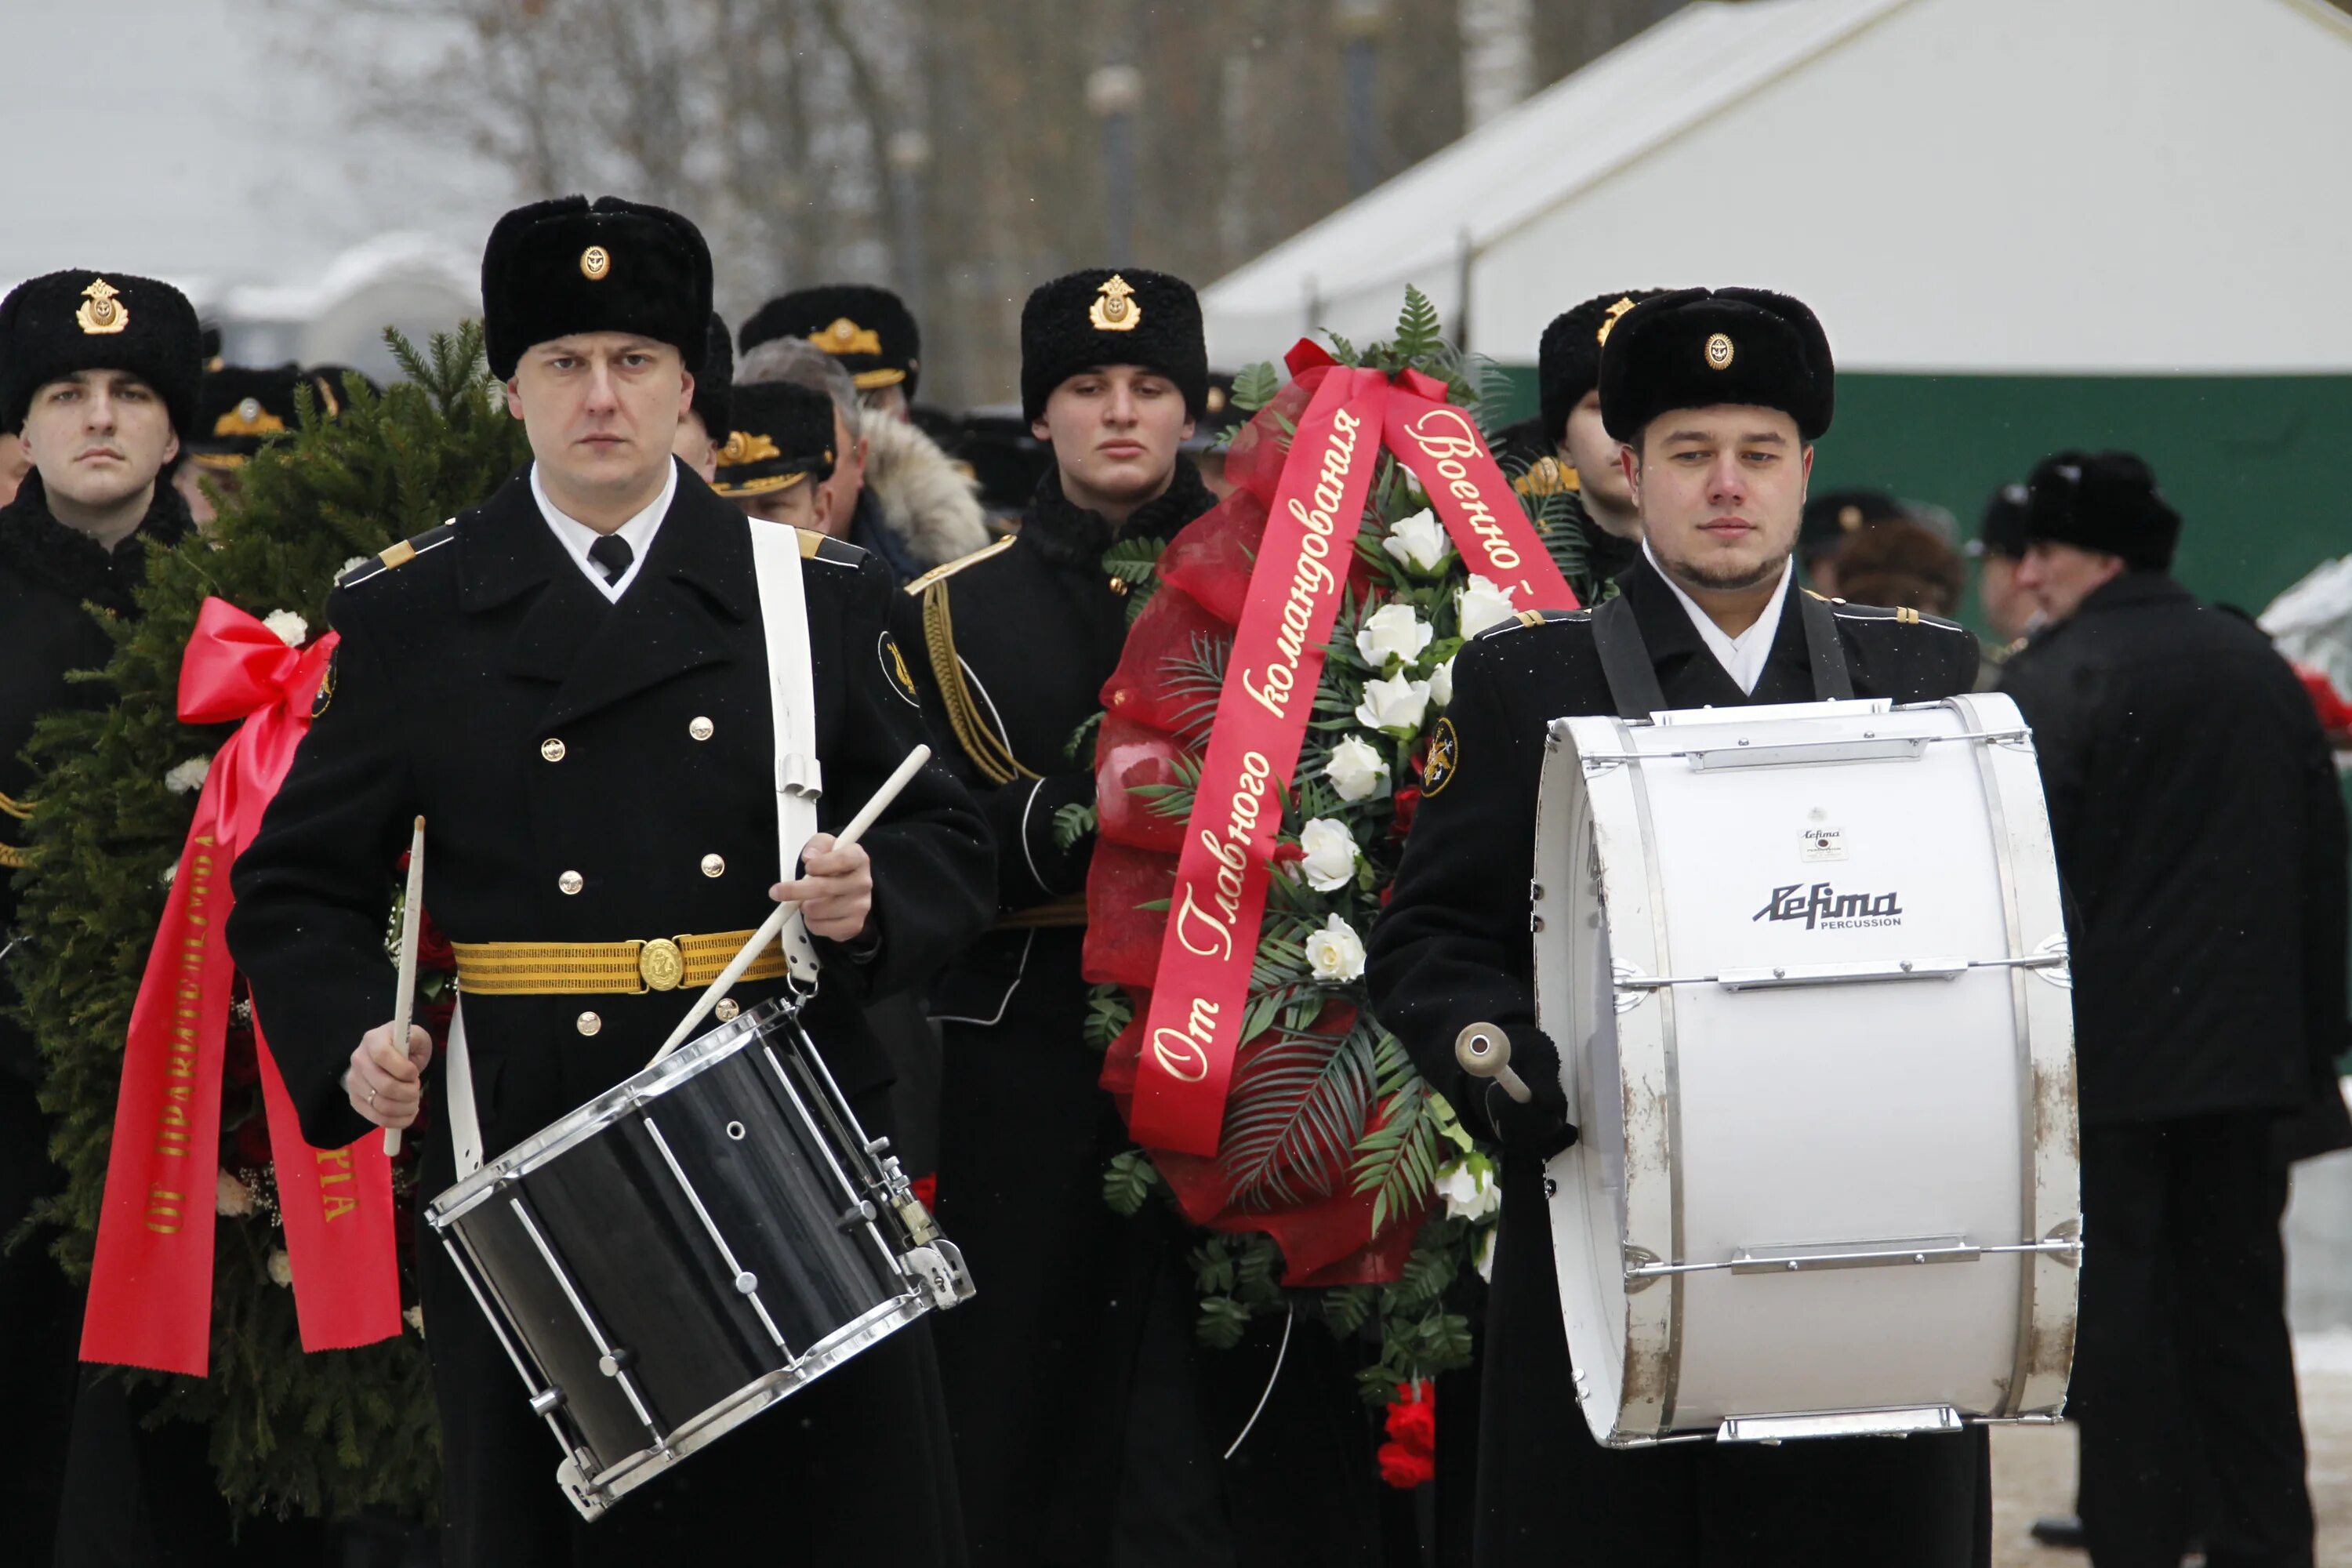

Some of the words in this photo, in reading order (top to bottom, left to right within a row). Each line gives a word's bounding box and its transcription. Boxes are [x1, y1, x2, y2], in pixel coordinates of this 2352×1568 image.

[1243, 408, 1361, 720] командования
[1177, 751, 1270, 961] Главного
[1752, 882, 1903, 931] Lefima
[1820, 917, 1902, 931] PERCUSSION
[1153, 998, 1219, 1082] От
[145, 1182, 186, 1234] ОТ
